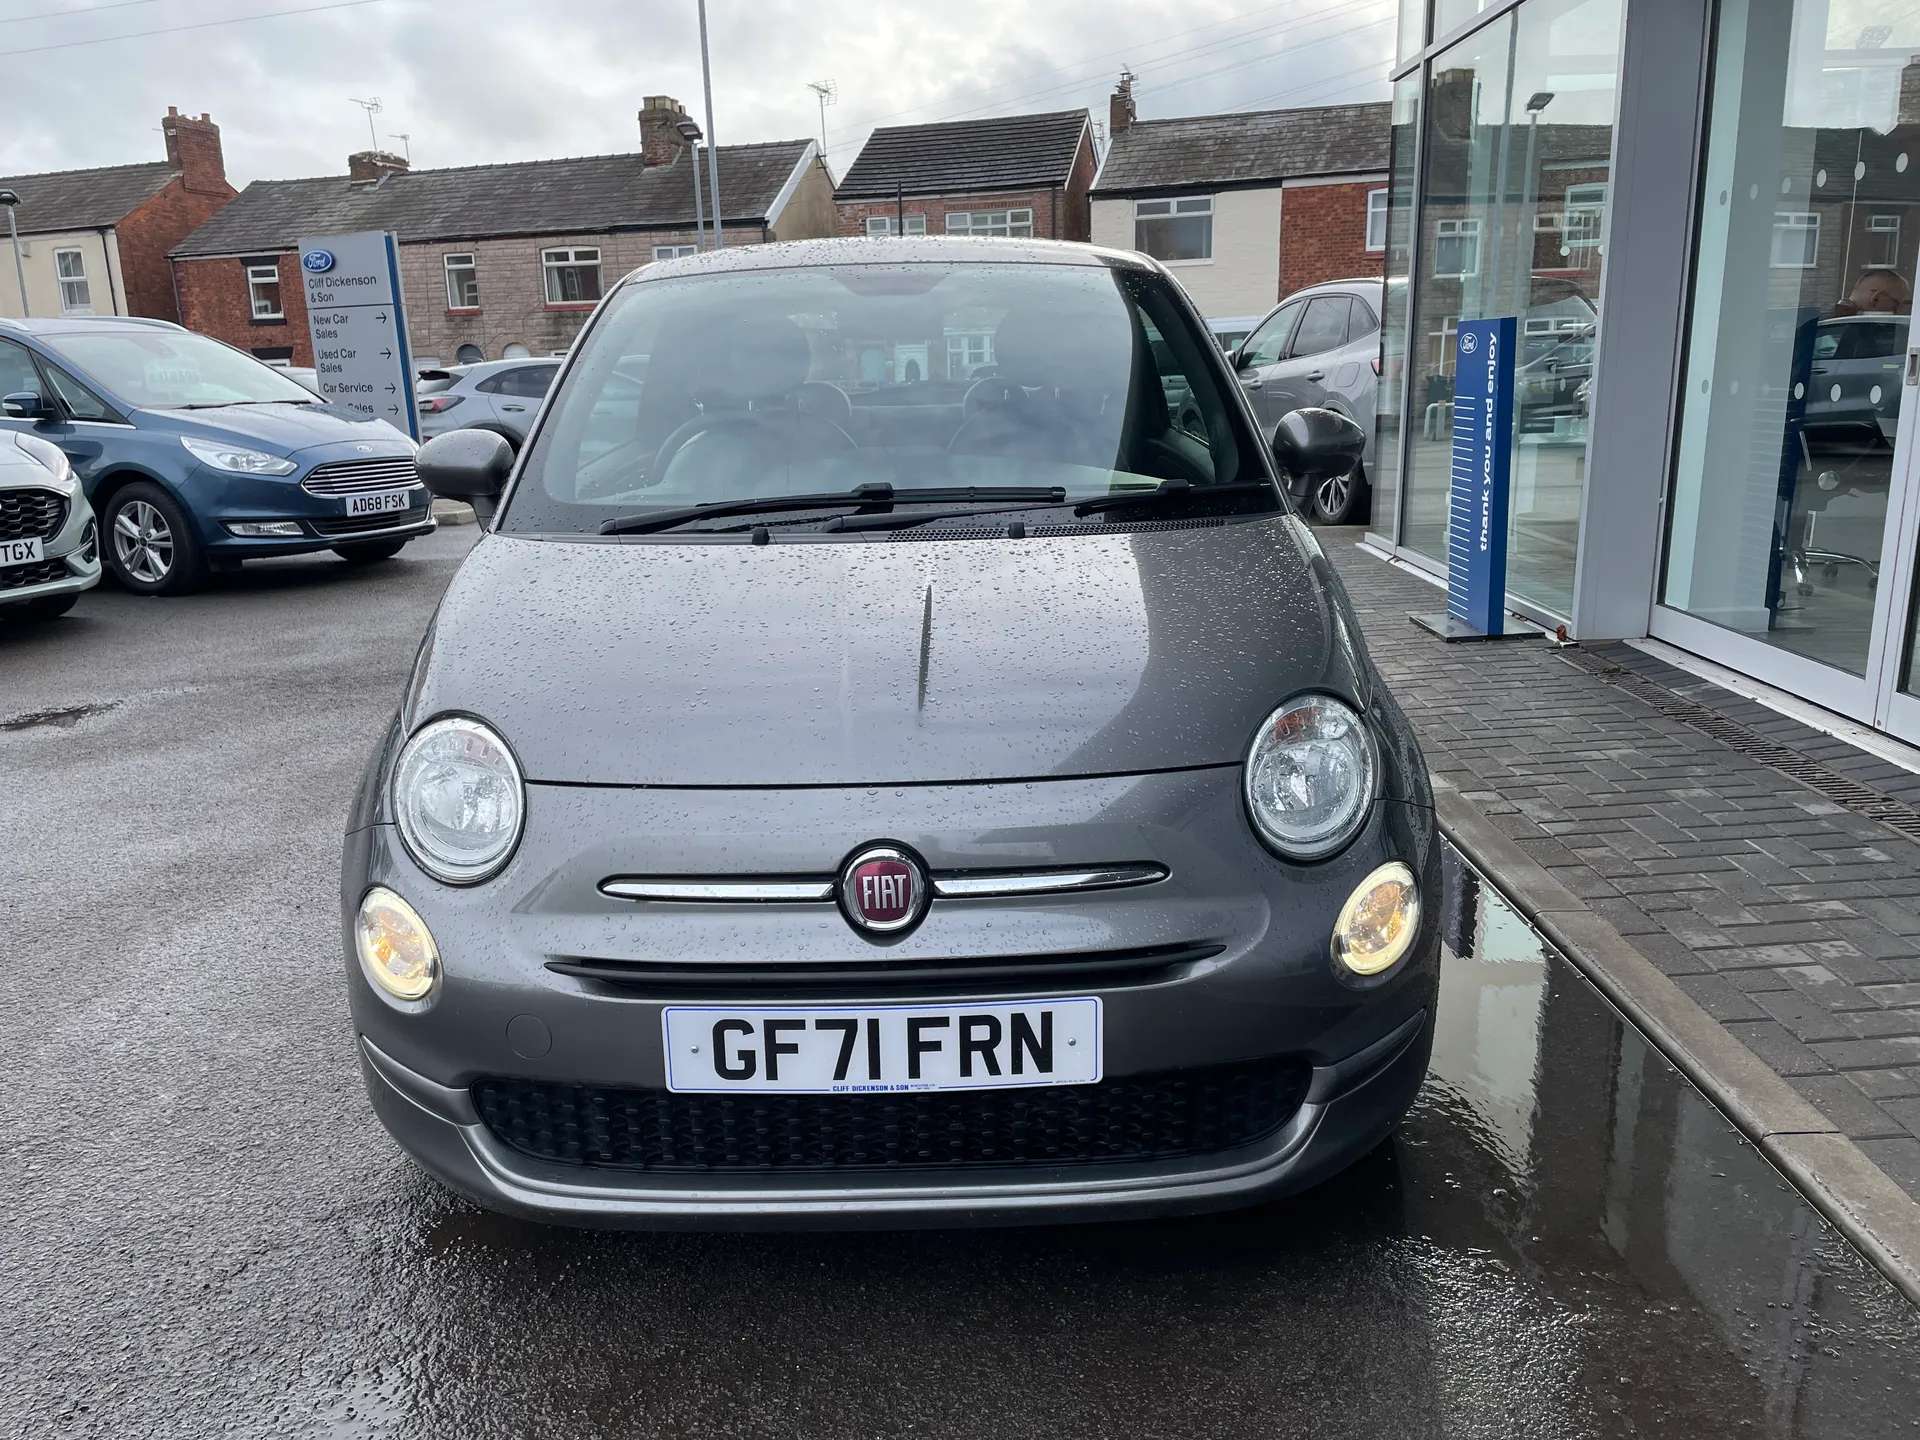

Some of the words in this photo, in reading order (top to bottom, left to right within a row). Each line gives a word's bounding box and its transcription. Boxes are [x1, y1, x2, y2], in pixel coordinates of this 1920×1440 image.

[308, 277, 323, 289] Cliff
[326, 275, 377, 288] Dickenson
[310, 293, 316, 303] &
[317, 292, 334, 302] Son
[313, 315, 331, 325] New
[332, 314, 348, 324] Car
[315, 329, 338, 339] Sales
[318, 349, 338, 359] Used
[340, 348, 356, 358] Car
[320, 363, 343, 373] Sales
[323, 383, 337, 393] Car
[338, 383, 374, 393] Service
[1480, 489, 1489, 552] thank
[1487, 332, 1496, 394] enjoy
[352, 496, 382, 513] AD68
[384, 493, 406, 509] FSK
[0, 541, 35, 563] TGX
[862, 874, 907, 910] FIAT
[711, 1017, 881, 1081] GF71
[907, 1010, 1054, 1080] FRN
